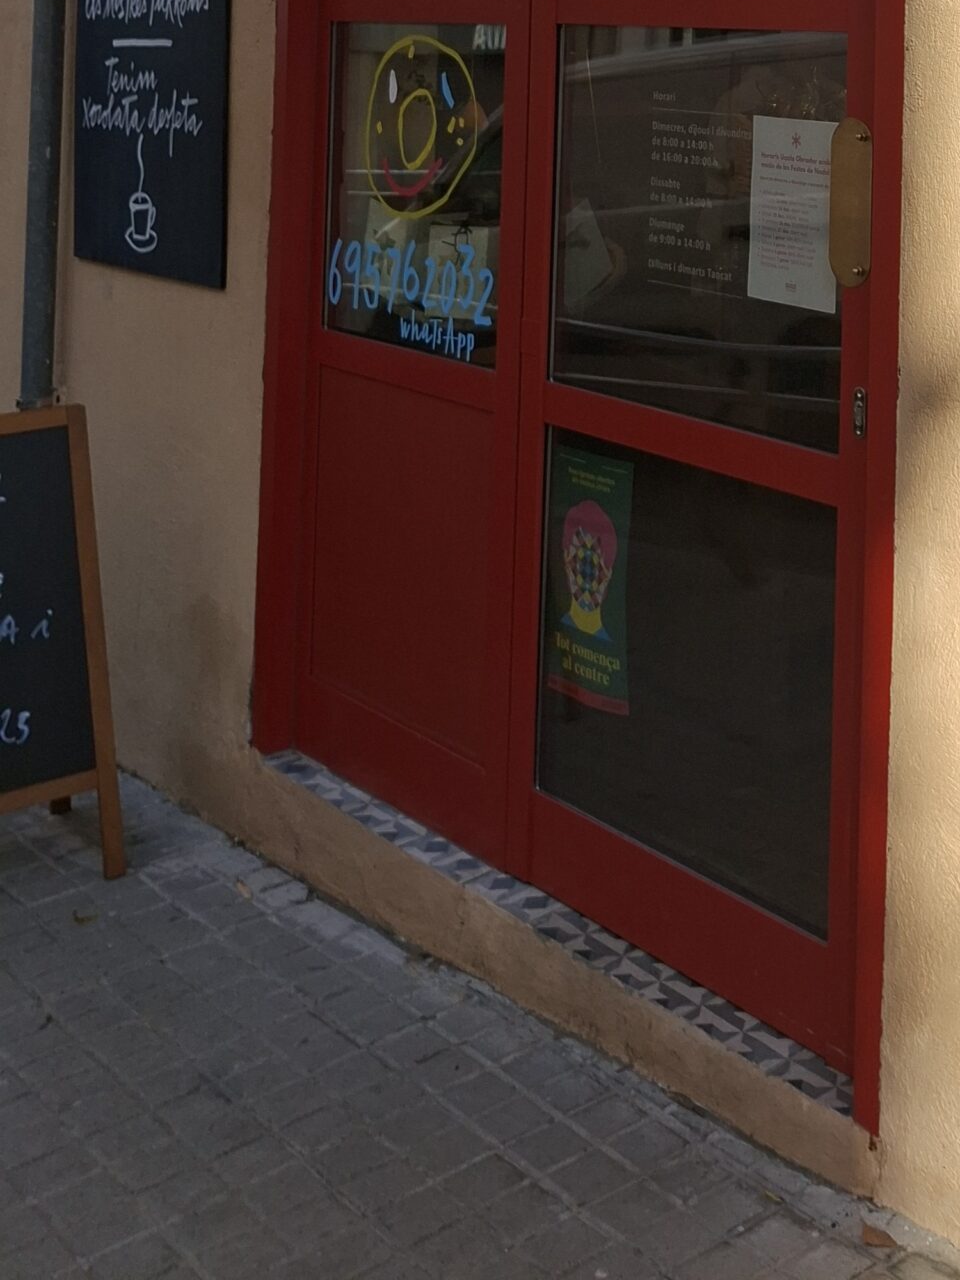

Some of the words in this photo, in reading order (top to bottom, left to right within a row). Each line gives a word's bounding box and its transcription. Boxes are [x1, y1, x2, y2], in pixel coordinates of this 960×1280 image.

[104, 57, 158, 96] Tenim
[652, 91, 677, 102] Horari
[651, 135, 661, 145] de
[662, 136, 679, 147] 8:00
[680, 139, 686, 148] a
[687, 139, 708, 151] 14:00
[651, 151, 661, 161] de
[648, 231, 659, 243] de
[659, 233, 676, 247] 9:00
[683, 237, 705, 251] 14:00
[706, 267, 733, 282] Tancat
[554, 631, 571, 651] Tot
[572, 643, 621, 672] comença
[561, 655, 573, 671] al
[574, 663, 611, 686] centre
